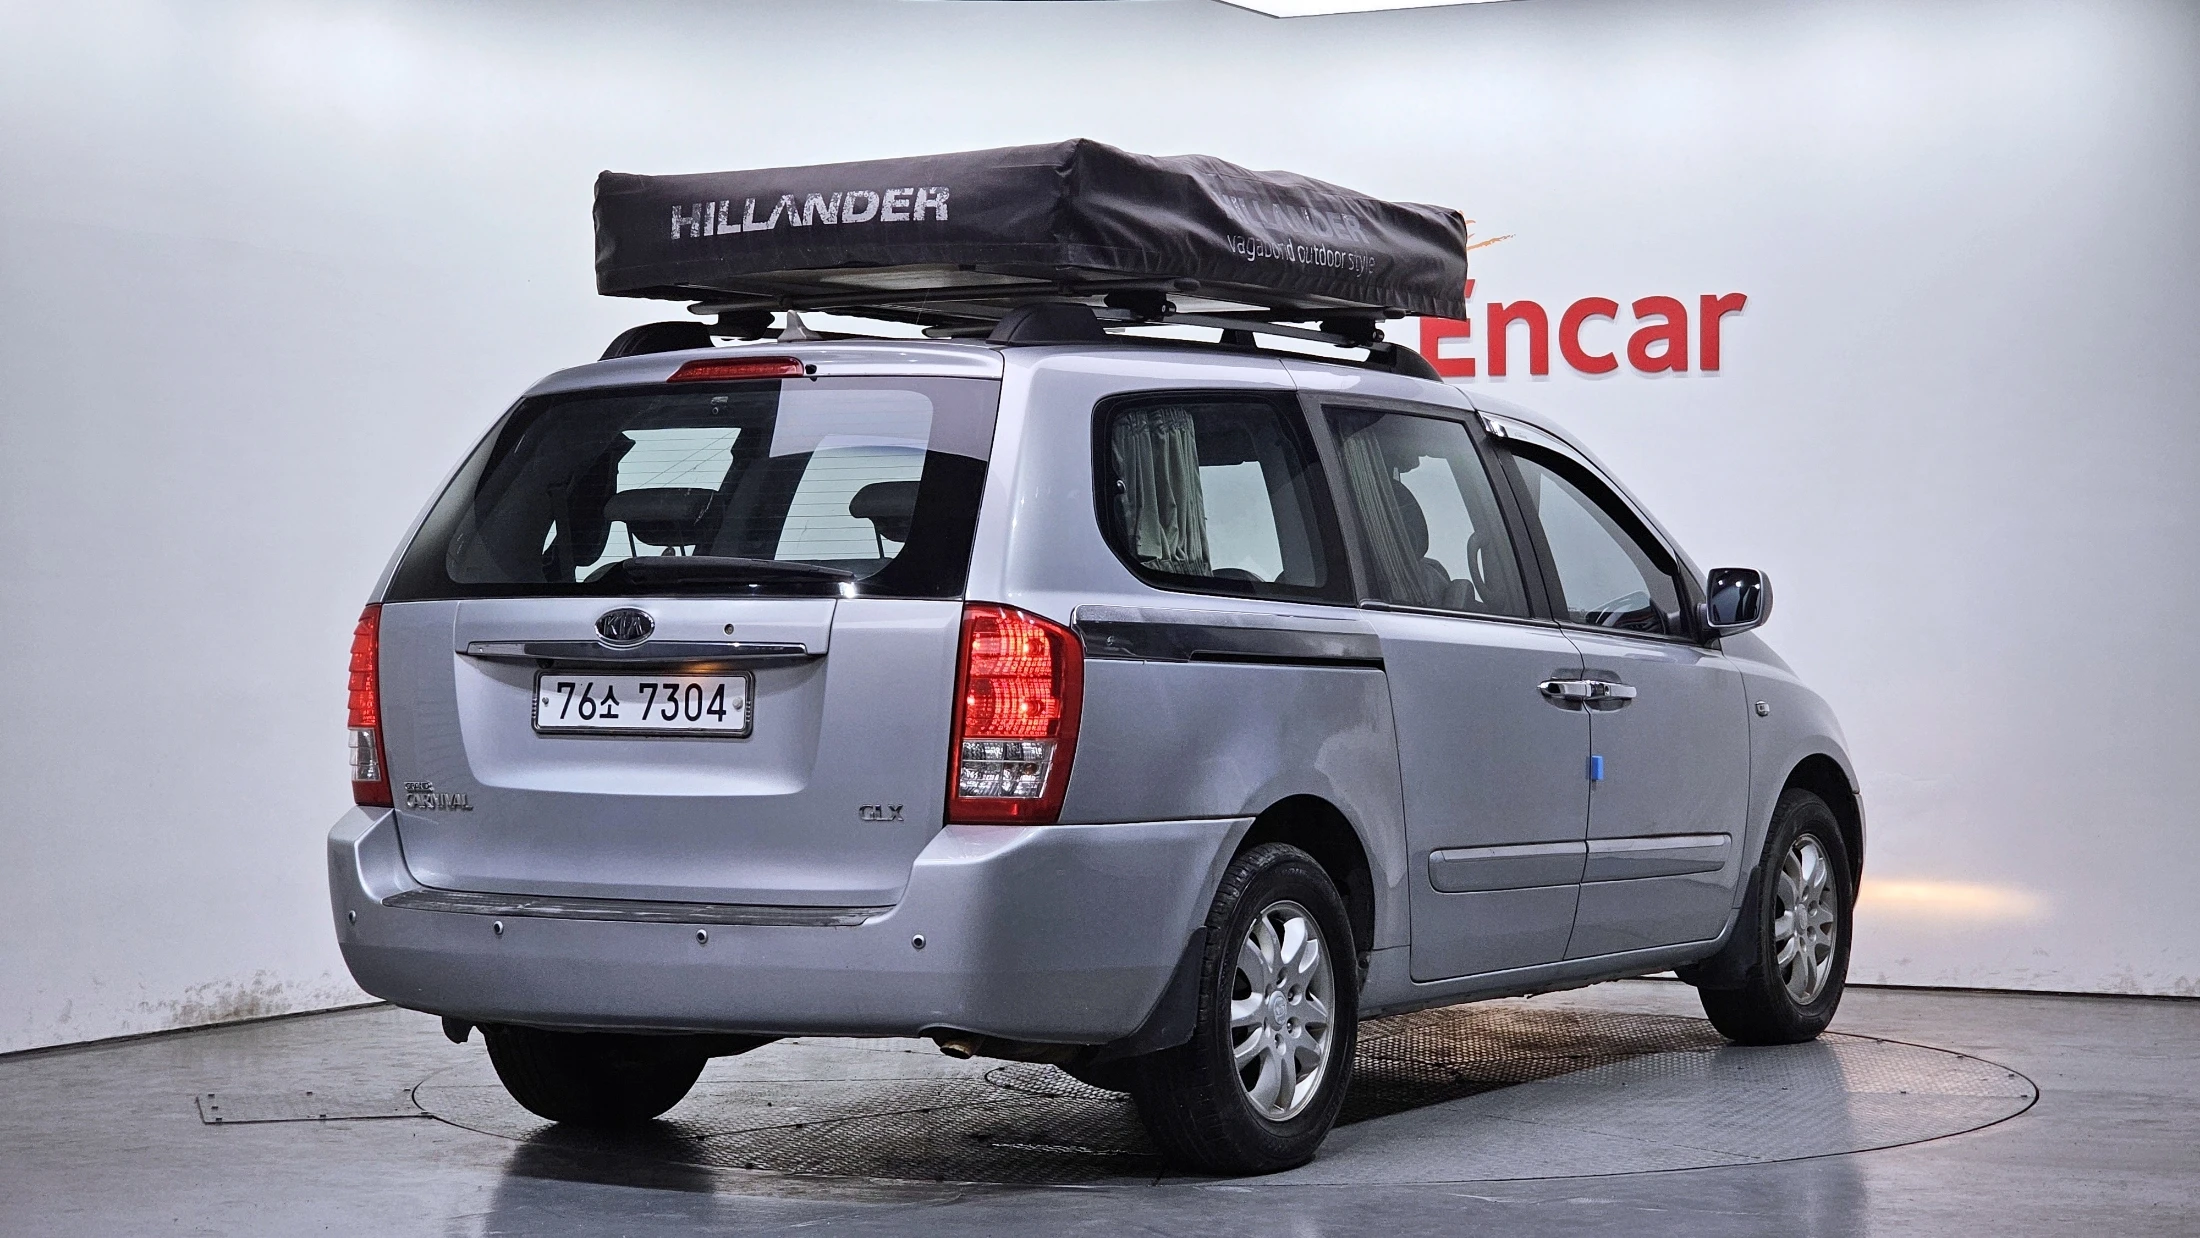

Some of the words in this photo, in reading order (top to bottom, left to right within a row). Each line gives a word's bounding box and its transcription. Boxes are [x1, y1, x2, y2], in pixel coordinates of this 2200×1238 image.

[671, 186, 950, 239] HILLANDER
[1227, 233, 1295, 262] vagabond
[1298, 244, 1346, 269] outdoor
[1348, 250, 1376, 277] style
[1420, 278, 1748, 377] Encar
[603, 614, 644, 637] KIA
[557, 682, 620, 720] 76소
[639, 682, 726, 722] 7304
[406, 793, 474, 811] CARNIVAL
[859, 804, 904, 821] GLX
